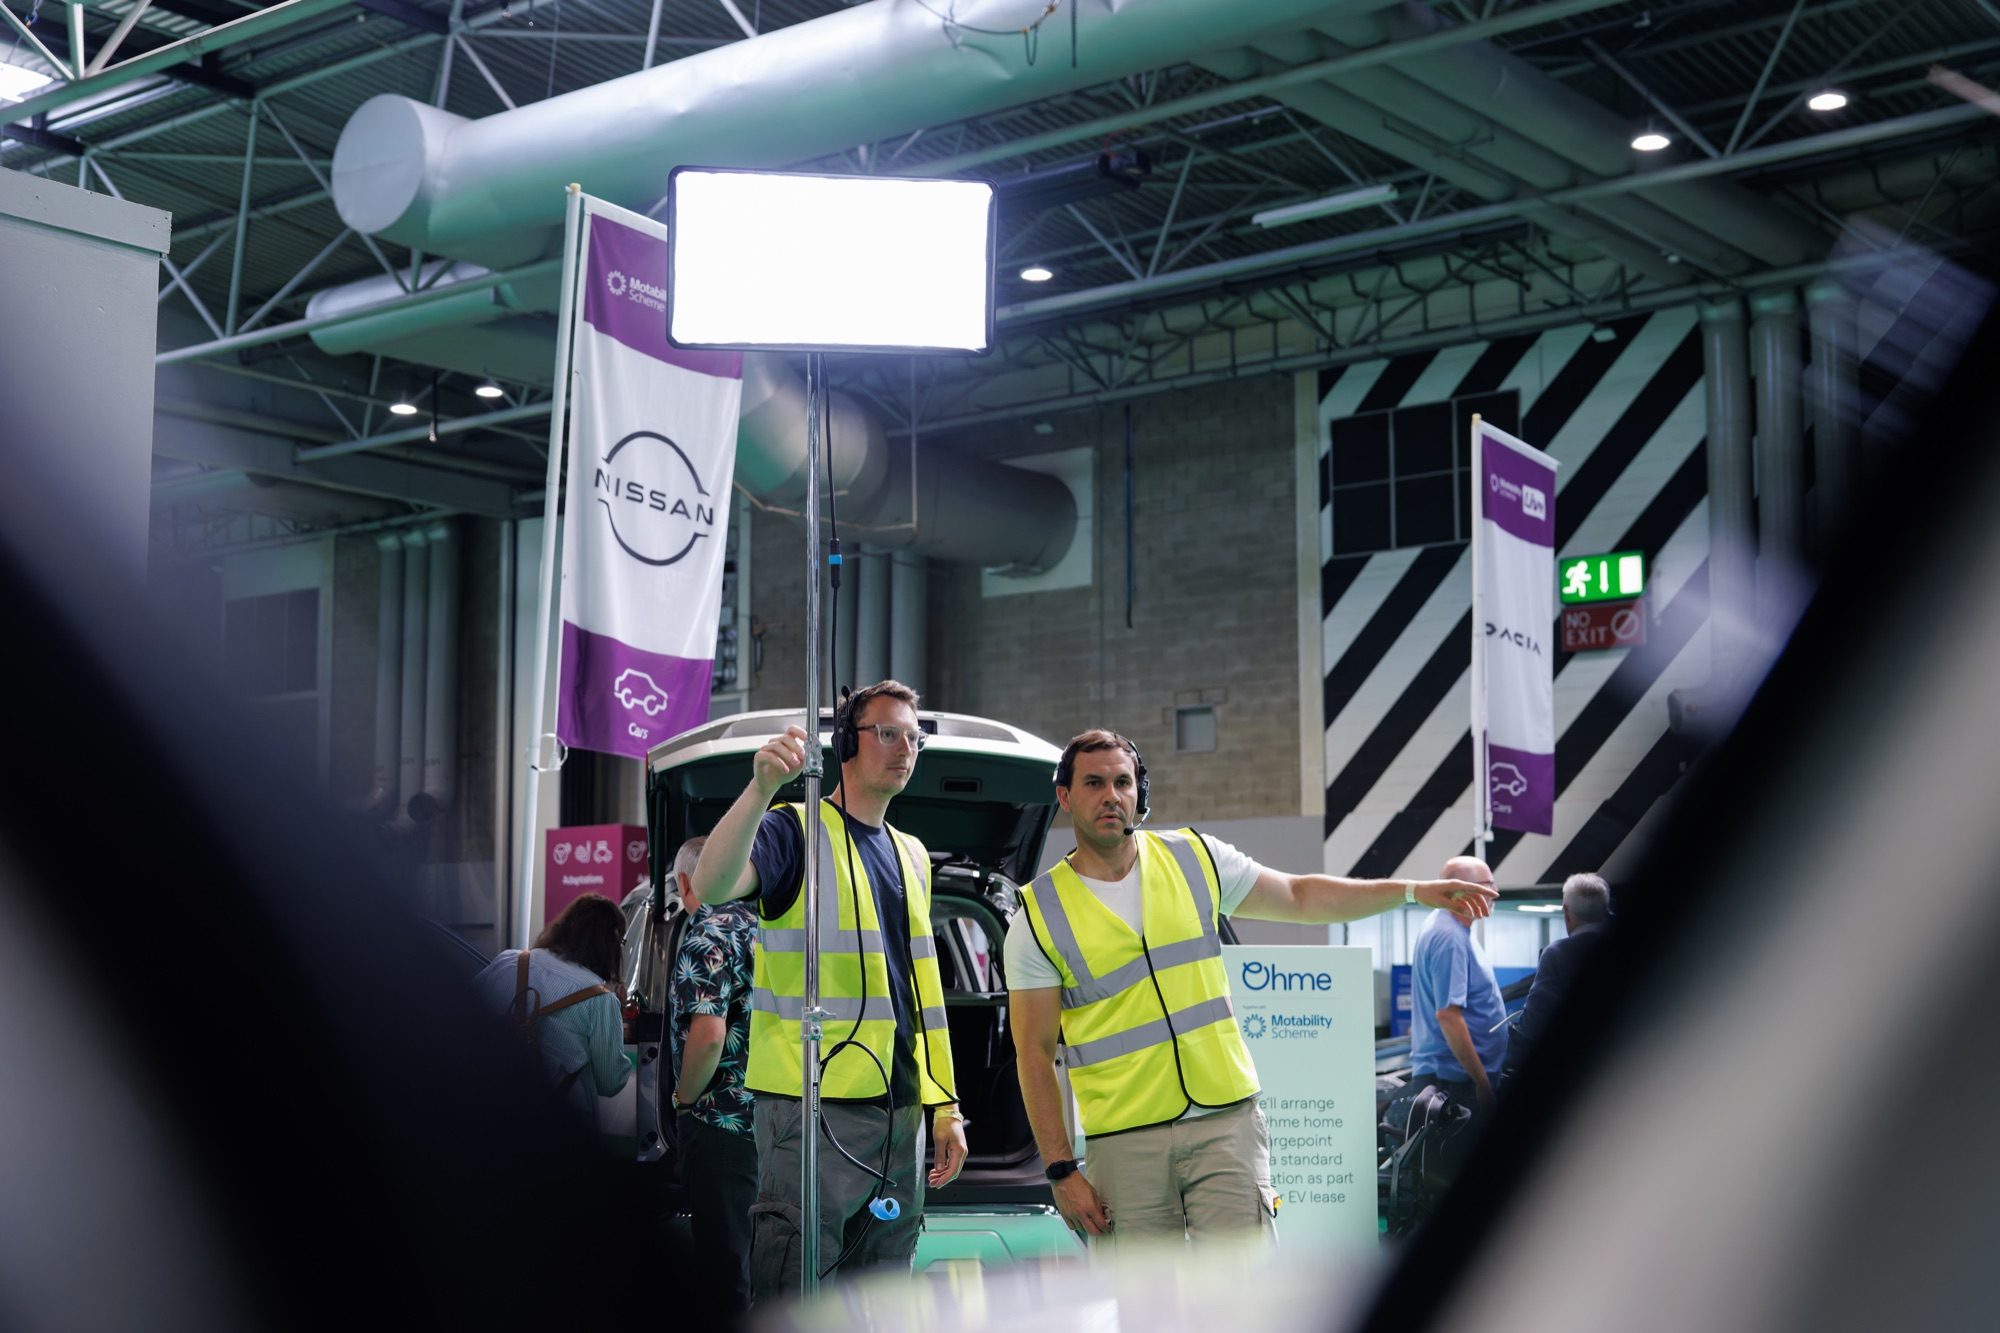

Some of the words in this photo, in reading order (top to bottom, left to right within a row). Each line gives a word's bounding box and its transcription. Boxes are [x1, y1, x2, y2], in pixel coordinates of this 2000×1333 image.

[630, 276, 667, 302] Motabil
[628, 288, 666, 312] Scheme
[594, 468, 714, 526] NISSAN
[1566, 610, 1592, 628] NO
[1485, 621, 1542, 655] DACIA
[1566, 626, 1609, 646] EXIT
[628, 722, 649, 739] Cars
[1242, 961, 1332, 991] Ohme
[1271, 1014, 1333, 1029] Motability
[1271, 1027, 1319, 1039] Scheme
[1257, 1096, 1277, 1109] e'll
[1280, 1099, 1335, 1112] arrange
[1304, 1115, 1343, 1128] home
[1270, 1135, 1333, 1150] rgepoint
[1280, 1153, 1343, 1166] standard
[1270, 1172, 1303, 1184] ation
[1307, 1174, 1323, 1185] as
[1326, 1171, 1354, 1187] part
[1288, 1190, 1307, 1203] EV
[1310, 1190, 1346, 1203] lease
